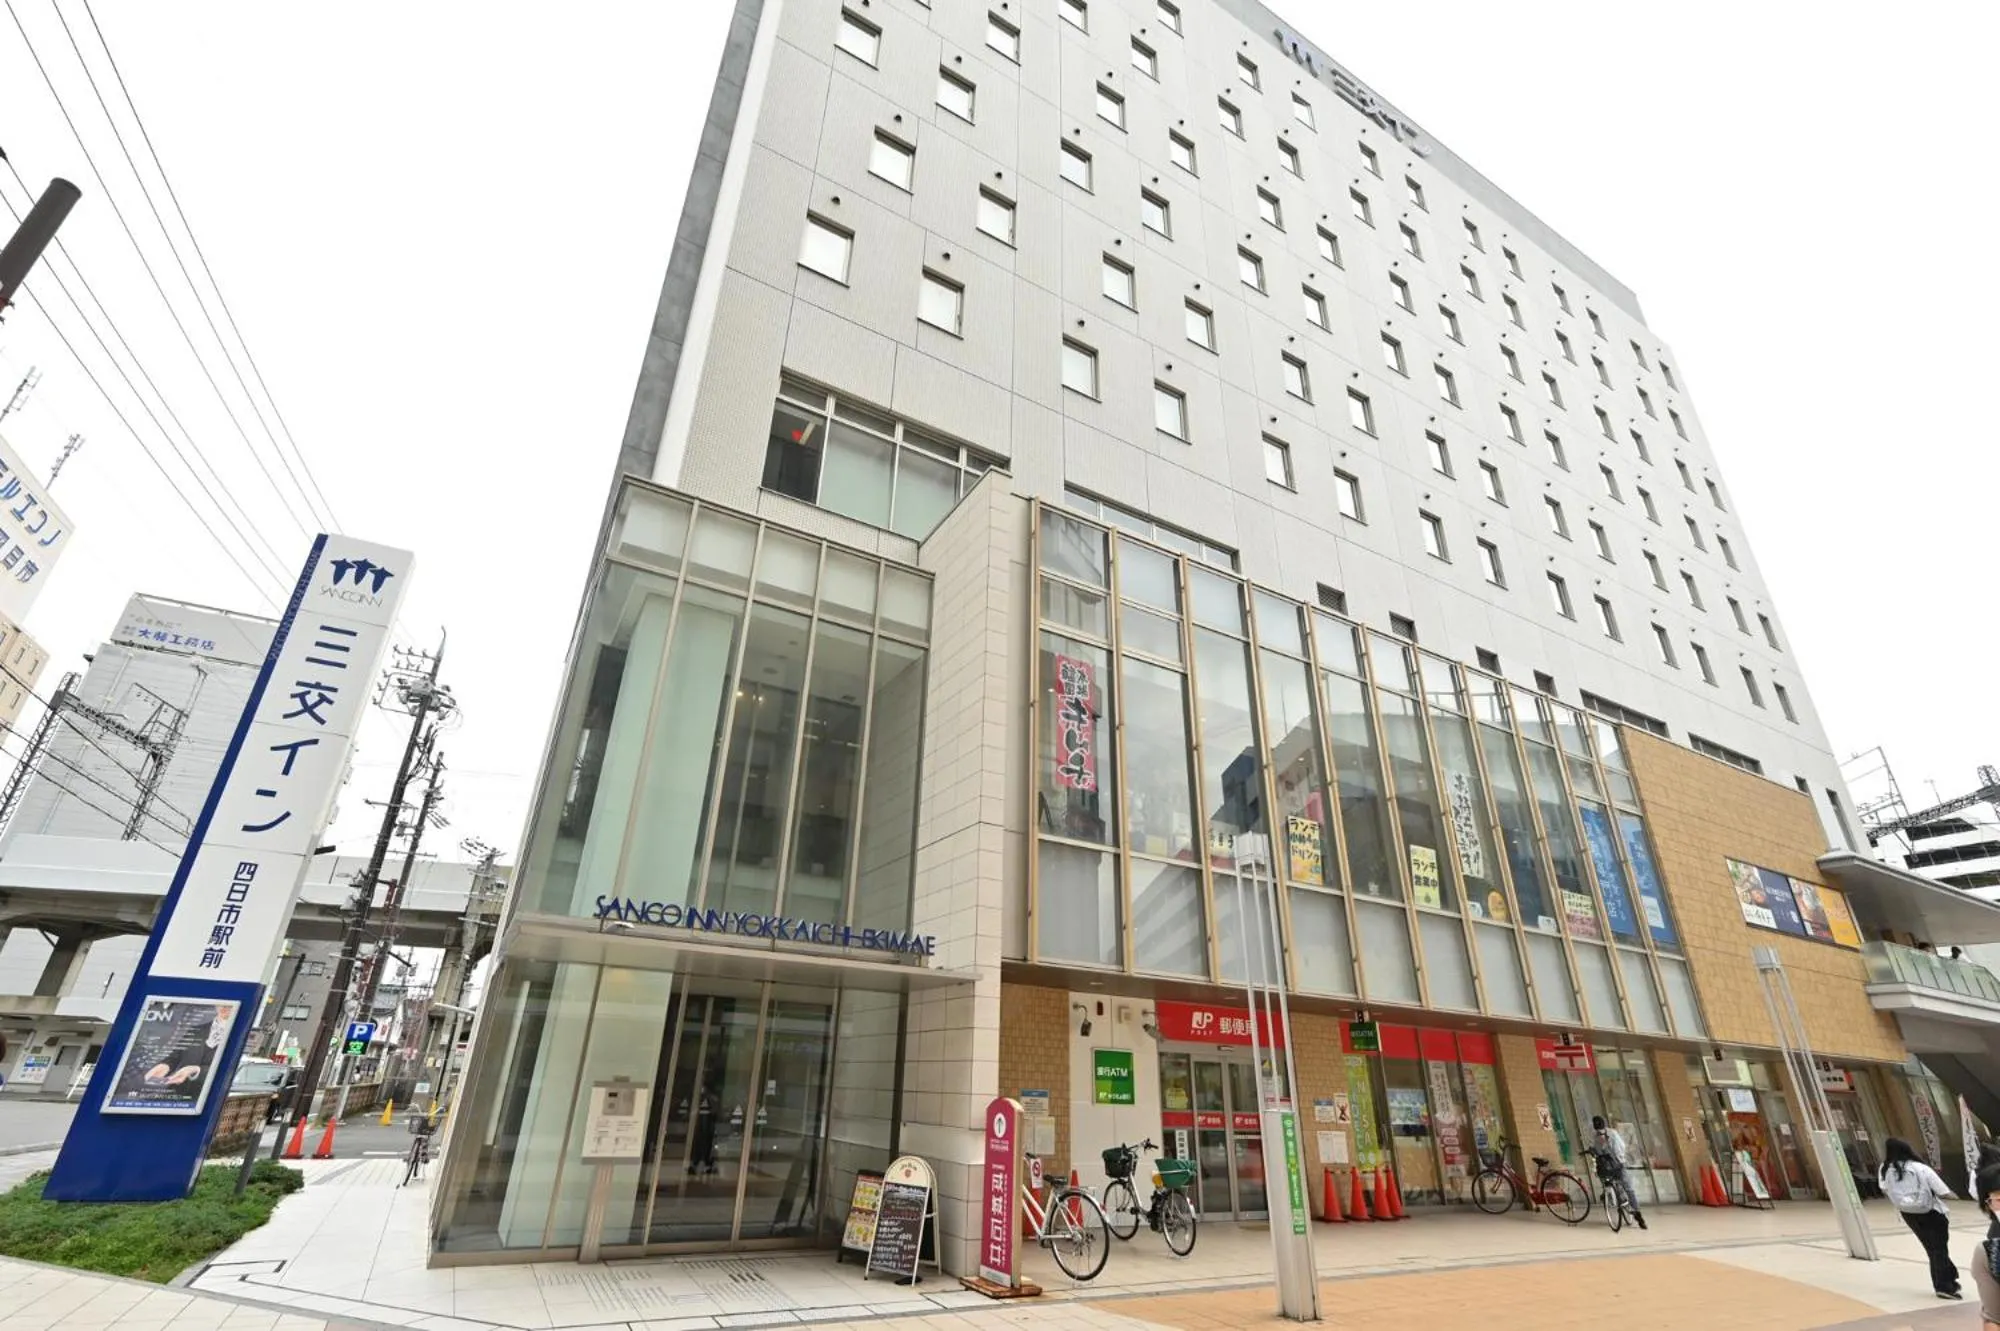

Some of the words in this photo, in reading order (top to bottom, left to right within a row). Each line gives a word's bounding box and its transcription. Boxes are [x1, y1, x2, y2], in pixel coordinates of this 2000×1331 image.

[1330, 68, 1430, 159] 三交イン
[241, 624, 358, 833] 三交イン
[1412, 858, 1436, 873] ランチ
[199, 861, 259, 969] 四日市駅前
[593, 894, 682, 925] SANCO
[687, 906, 730, 933] INN
[352, 1024, 369, 1039] P
[1096, 1066, 1129, 1077] 銀行ATM
